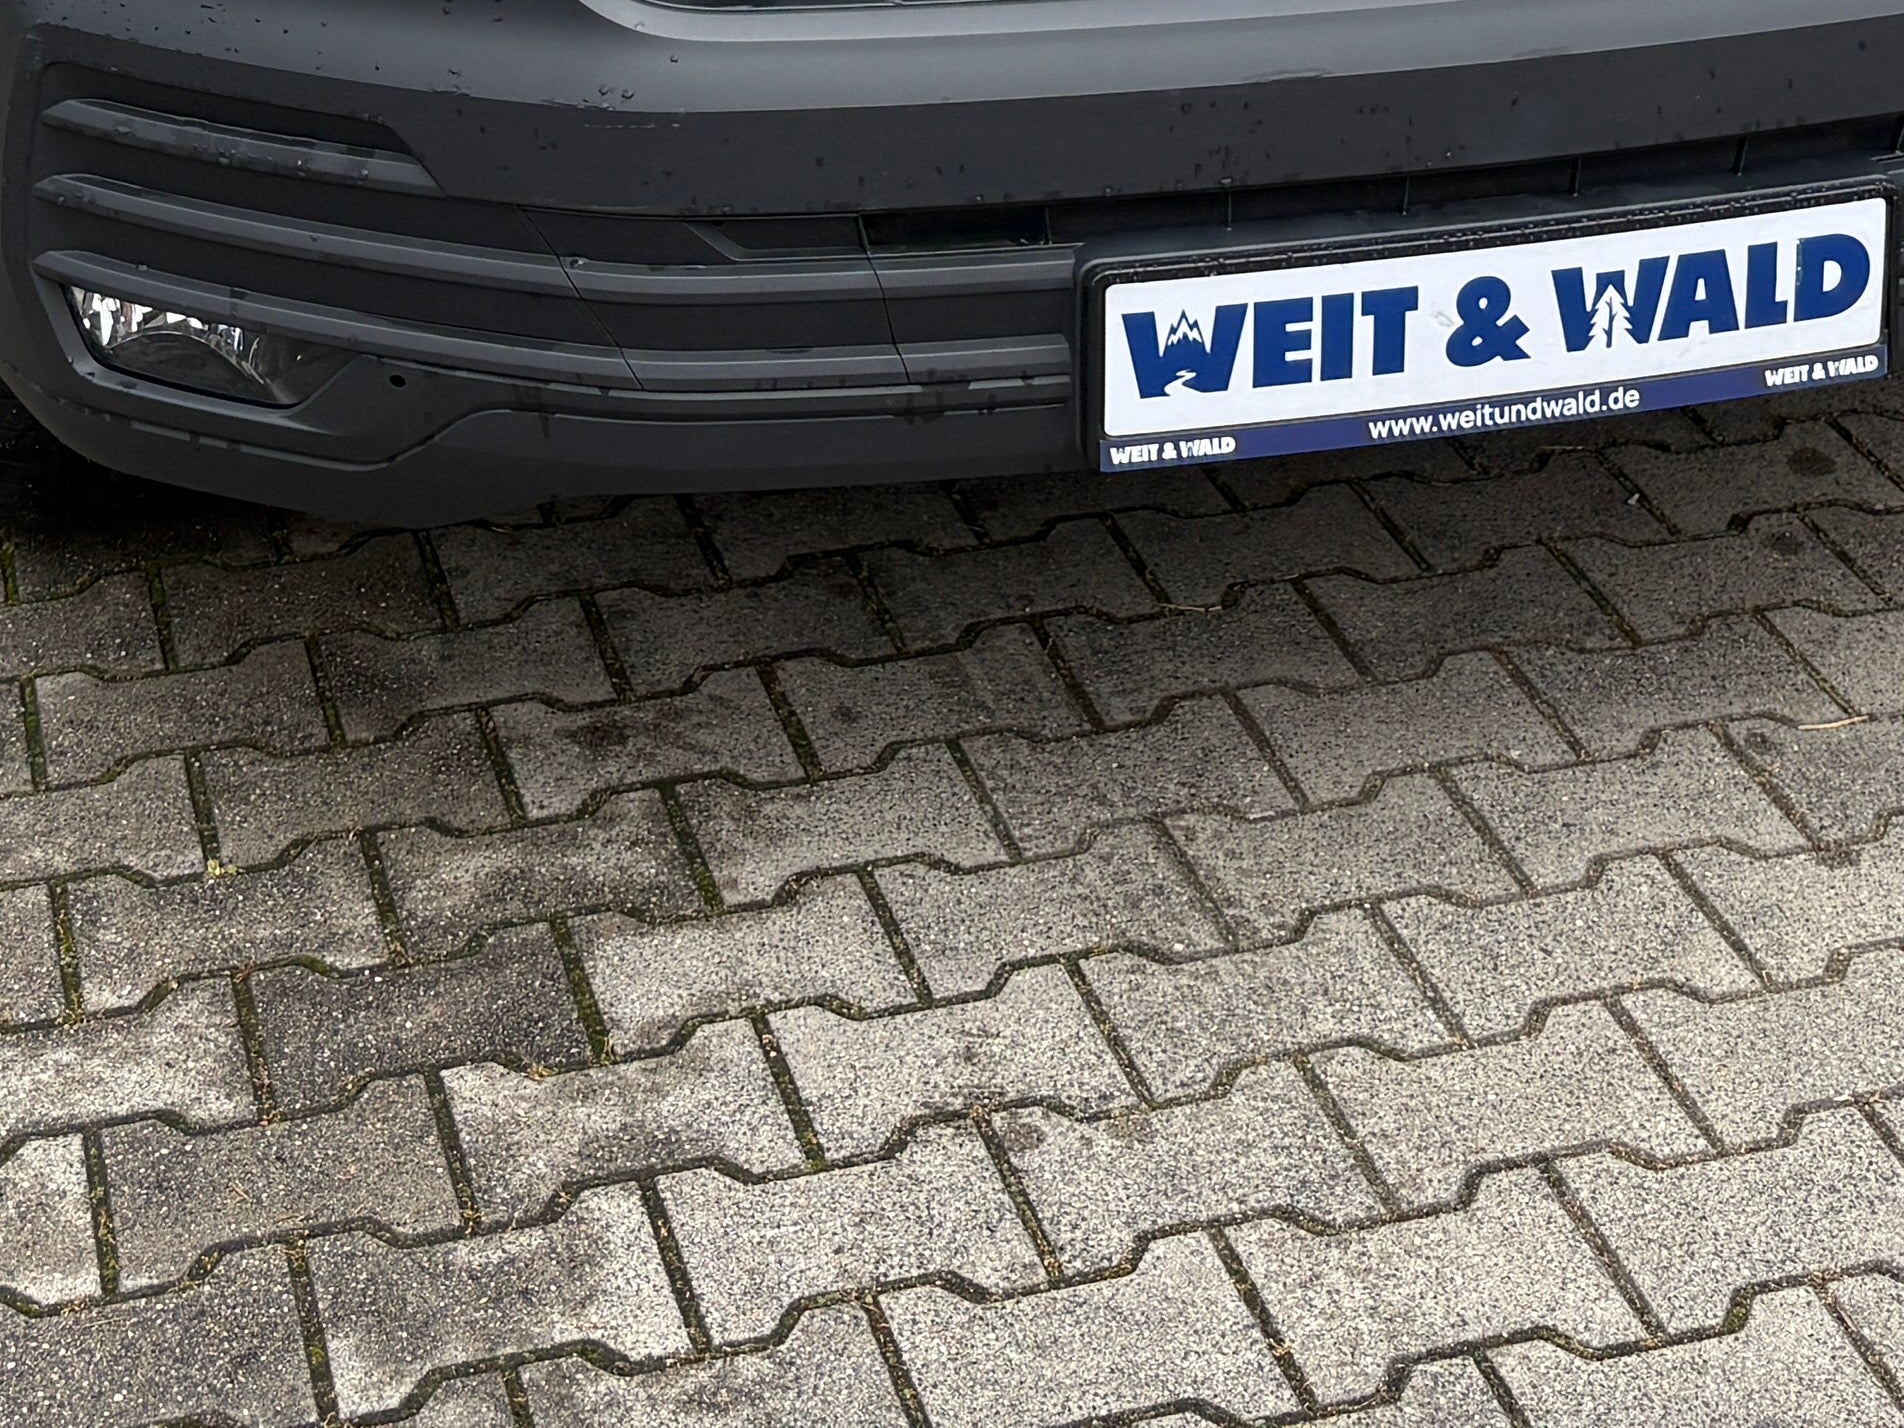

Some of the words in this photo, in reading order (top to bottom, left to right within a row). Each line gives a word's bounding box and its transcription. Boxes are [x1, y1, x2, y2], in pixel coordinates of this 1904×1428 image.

[1121, 285, 1419, 400] WEIT
[1445, 275, 1531, 368] &
[1551, 232, 1871, 353] WALD
[1764, 365, 1810, 387] WEIT
[1811, 362, 1826, 380] &
[1827, 355, 1879, 378] WALD
[1368, 387, 1640, 439] www.weitundwald.de
[1109, 443, 1159, 464] WEIT
[1161, 442, 1177, 460] &
[1179, 436, 1236, 458] WALD
